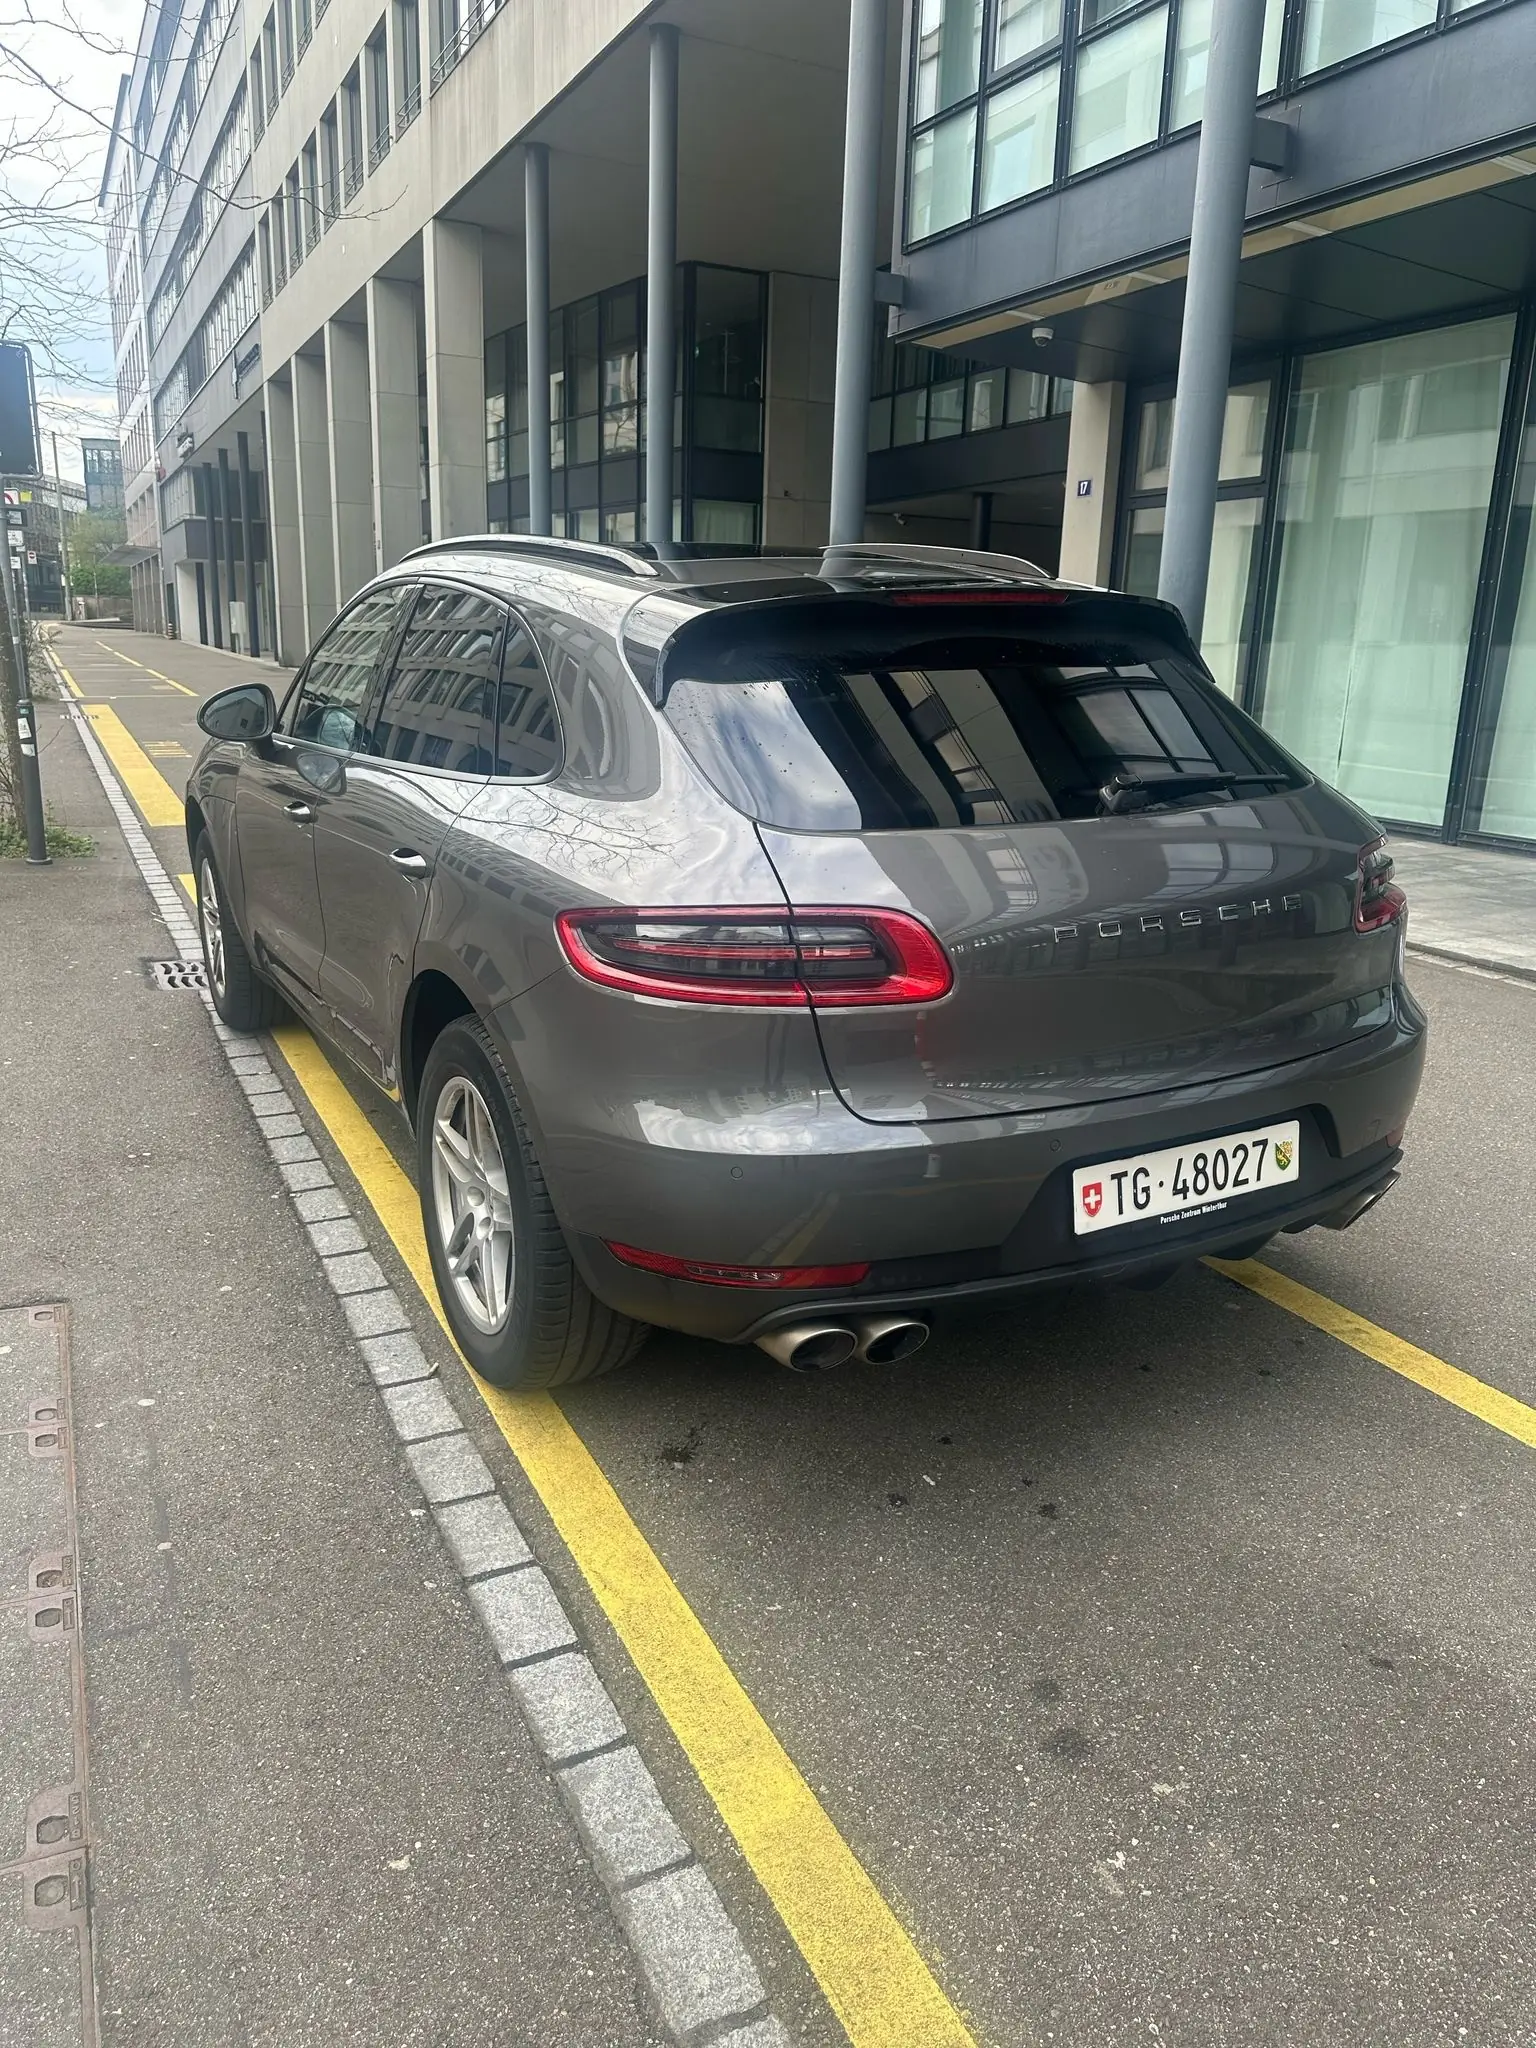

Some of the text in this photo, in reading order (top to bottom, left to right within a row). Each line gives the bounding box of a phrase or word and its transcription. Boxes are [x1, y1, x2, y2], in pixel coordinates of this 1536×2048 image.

[1079, 481, 1089, 495] 17
[1053, 893, 1302, 943] PORSCHE
[1160, 1201, 1228, 1225] Porsche Zentrum Winterthur
